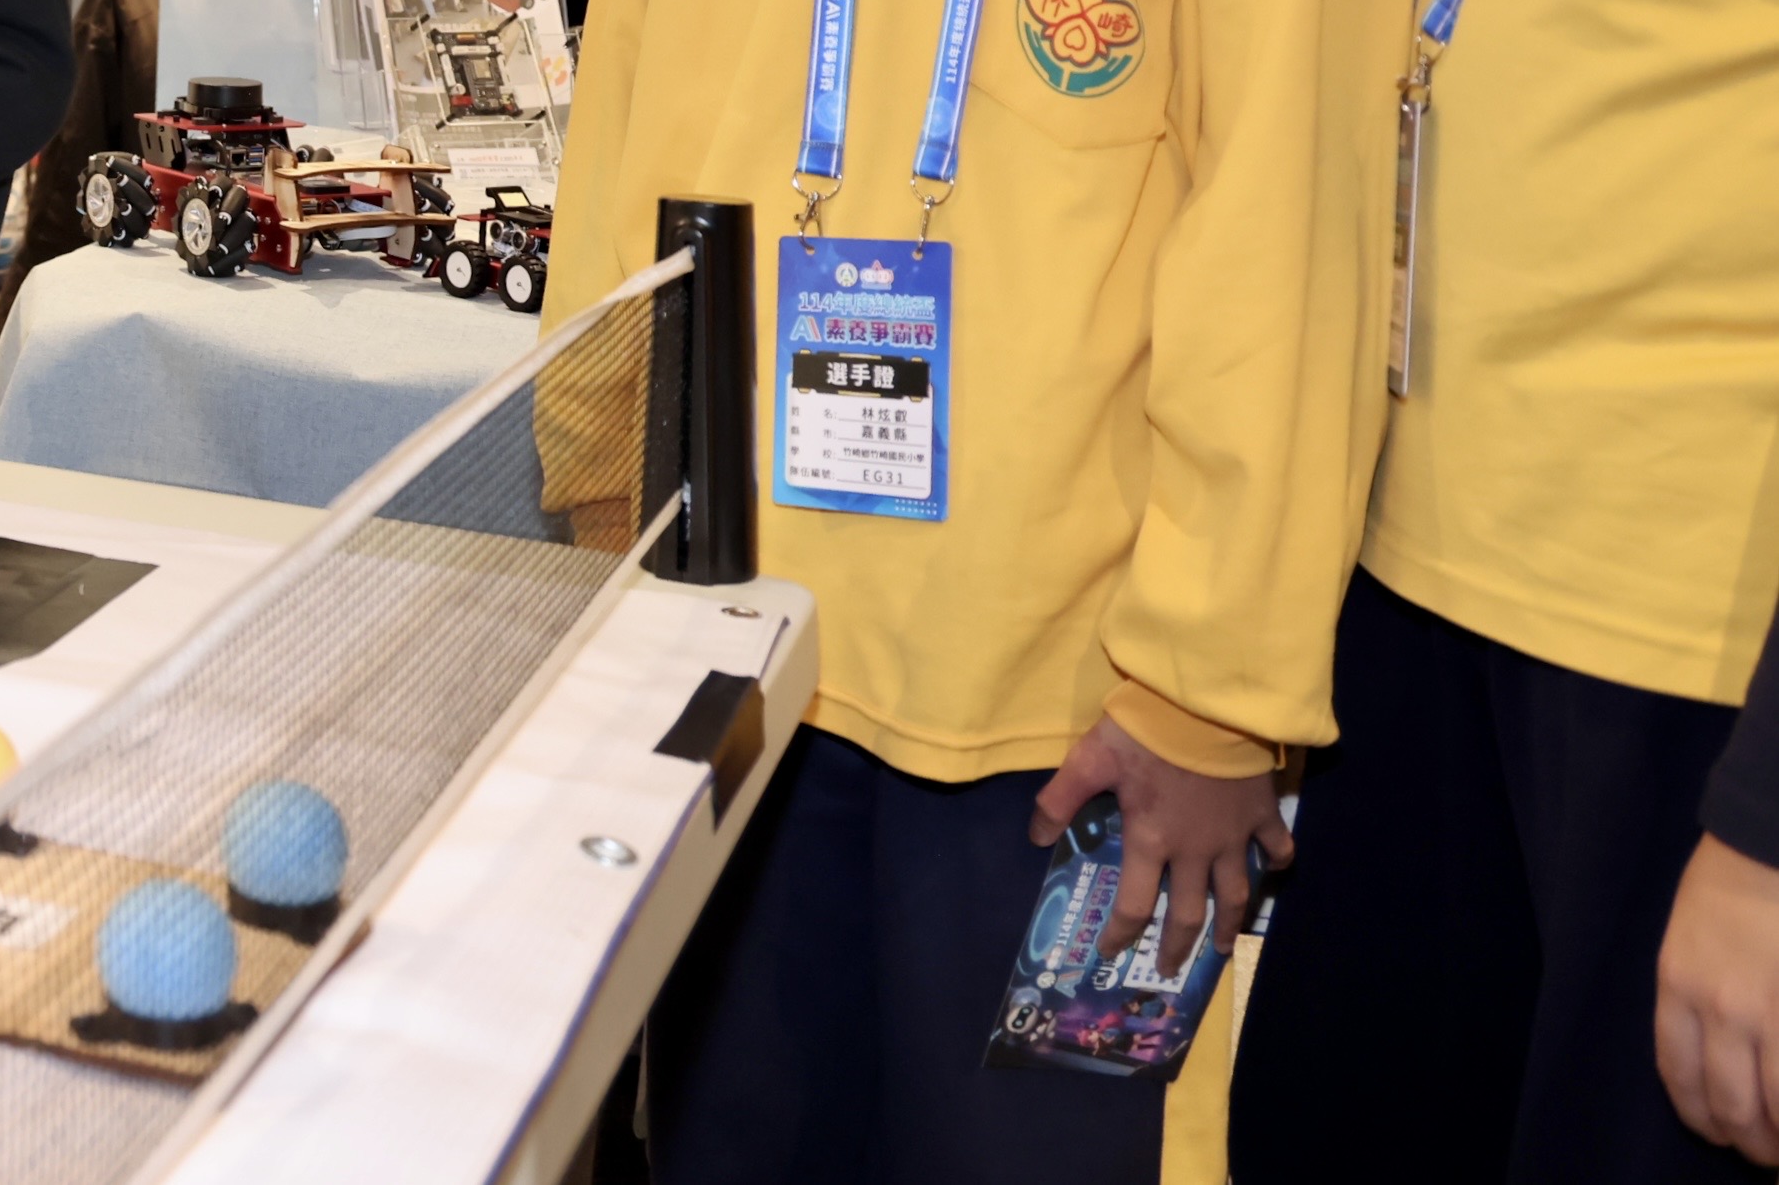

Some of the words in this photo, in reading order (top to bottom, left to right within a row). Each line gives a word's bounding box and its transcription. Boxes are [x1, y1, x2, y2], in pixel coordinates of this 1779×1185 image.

[826, 361, 896, 389] 選手證
[861, 425, 907, 441] 嘉義縣
